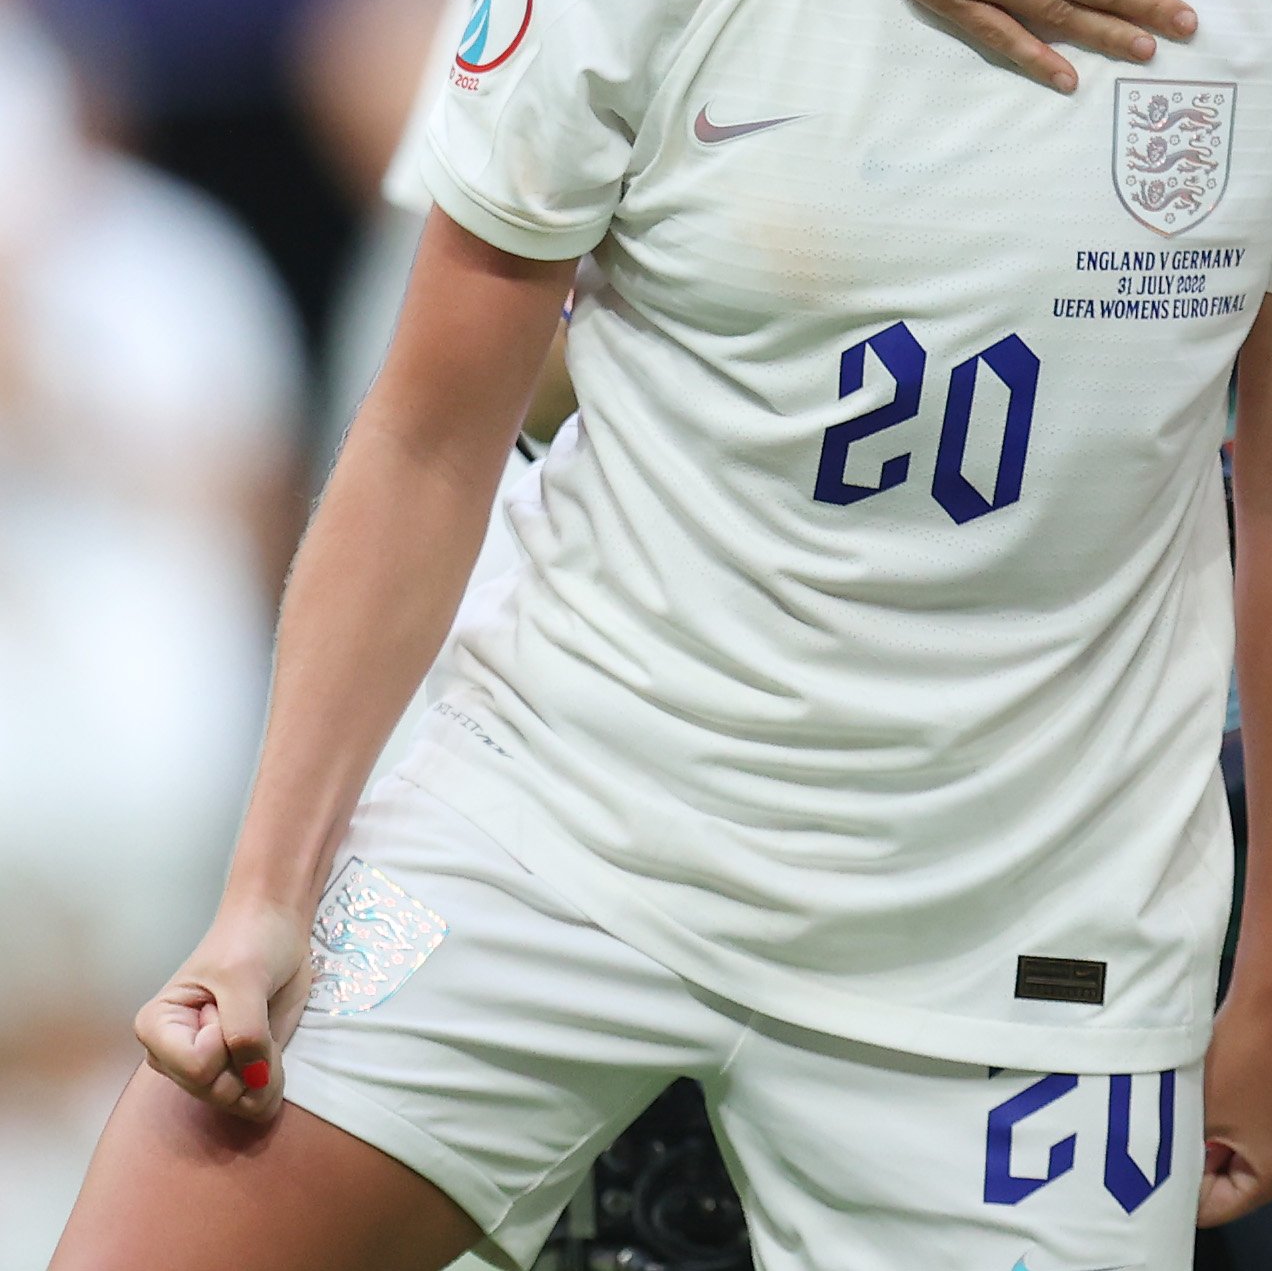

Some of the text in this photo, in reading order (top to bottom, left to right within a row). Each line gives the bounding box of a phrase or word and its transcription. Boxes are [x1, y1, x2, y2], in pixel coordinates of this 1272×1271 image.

[455, 73, 480, 91] 2022
[1076, 248, 1246, 271] ENGLAND V GERMANY
[1117, 274, 1206, 296] 31 JULY 2022
[1053, 294, 1246, 319] UEFA WOMENS EURO FINAL
[813, 320, 1041, 526] 20
